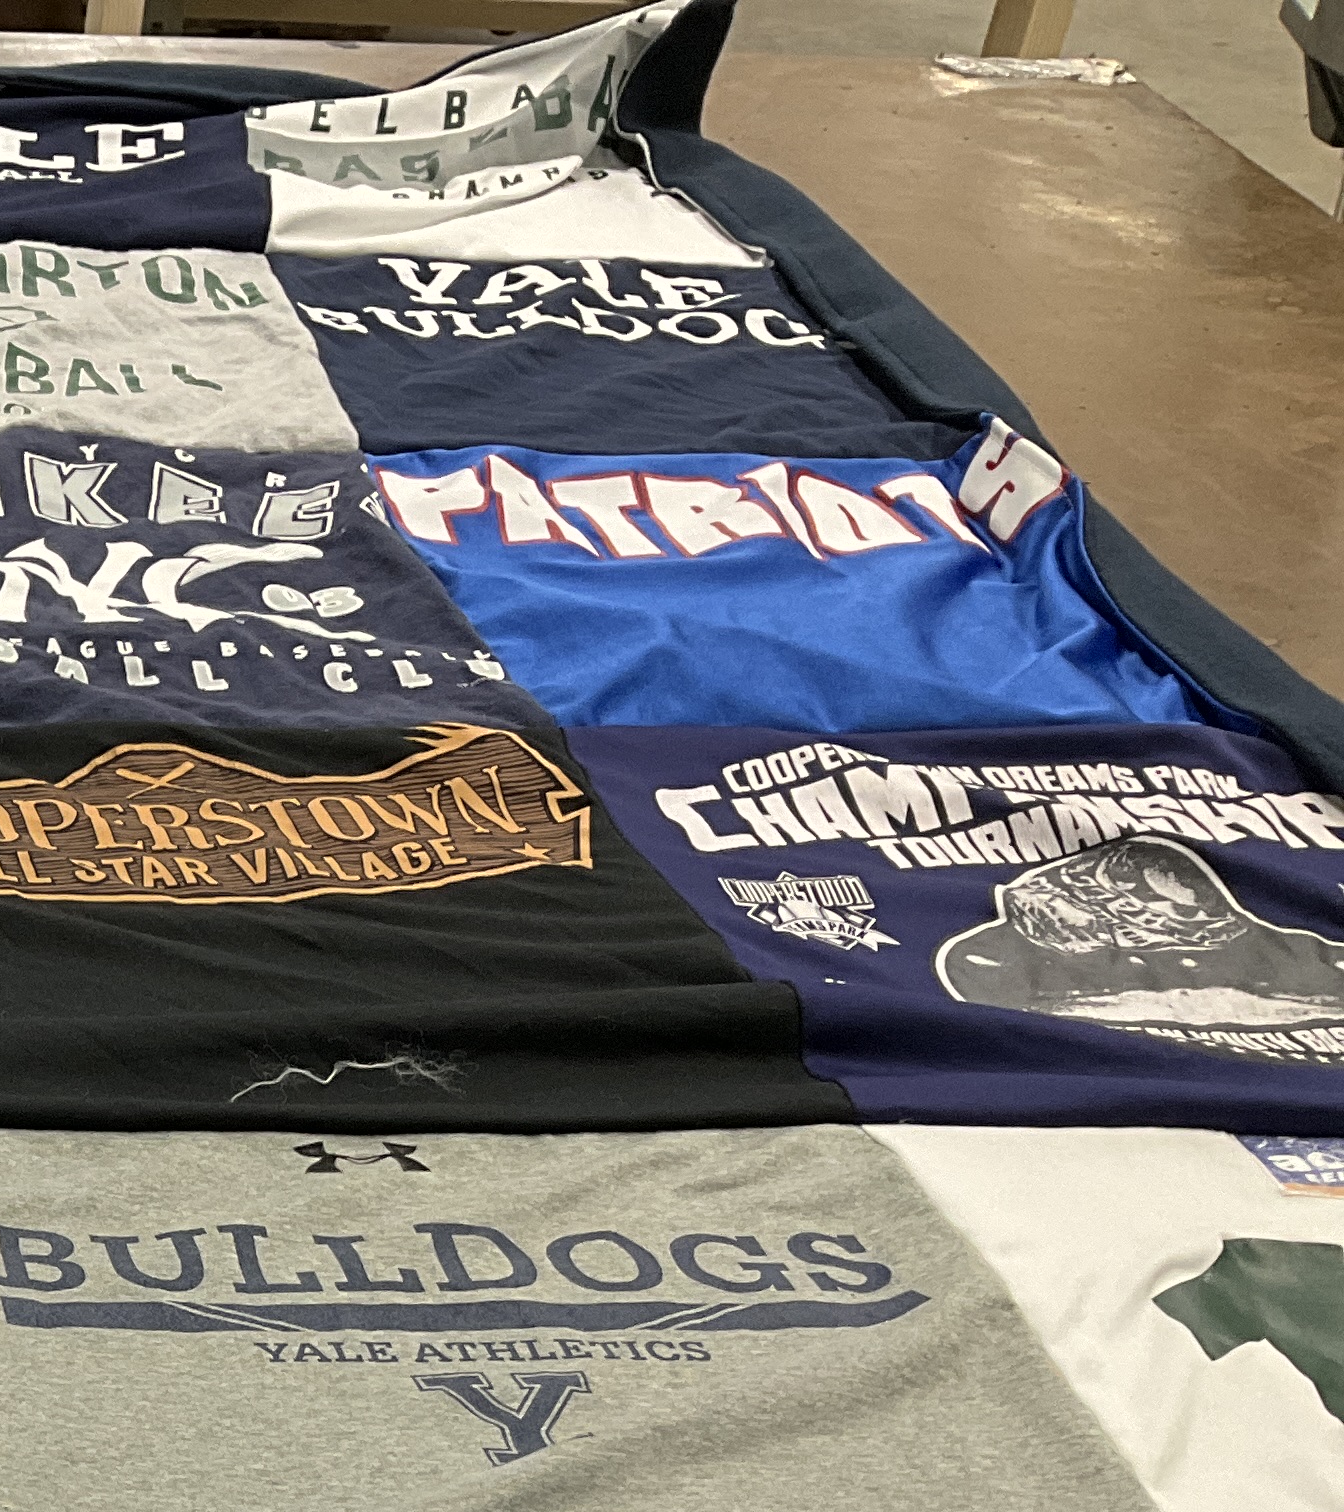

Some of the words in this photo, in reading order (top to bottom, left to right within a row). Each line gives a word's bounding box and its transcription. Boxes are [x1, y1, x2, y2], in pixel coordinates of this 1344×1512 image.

[374, 411, 1072, 562] PATRIOTS
[983, 763, 1144, 795] DREAMS
[1144, 765, 1254, 797] PARK
[69, 855, 219, 888] STAR
[230, 836, 469, 886] VILLAGE
[254, 1341, 399, 1363] YALE
[414, 1338, 713, 1363] ATHLETICS
[412, 1370, 593, 1468] Y
